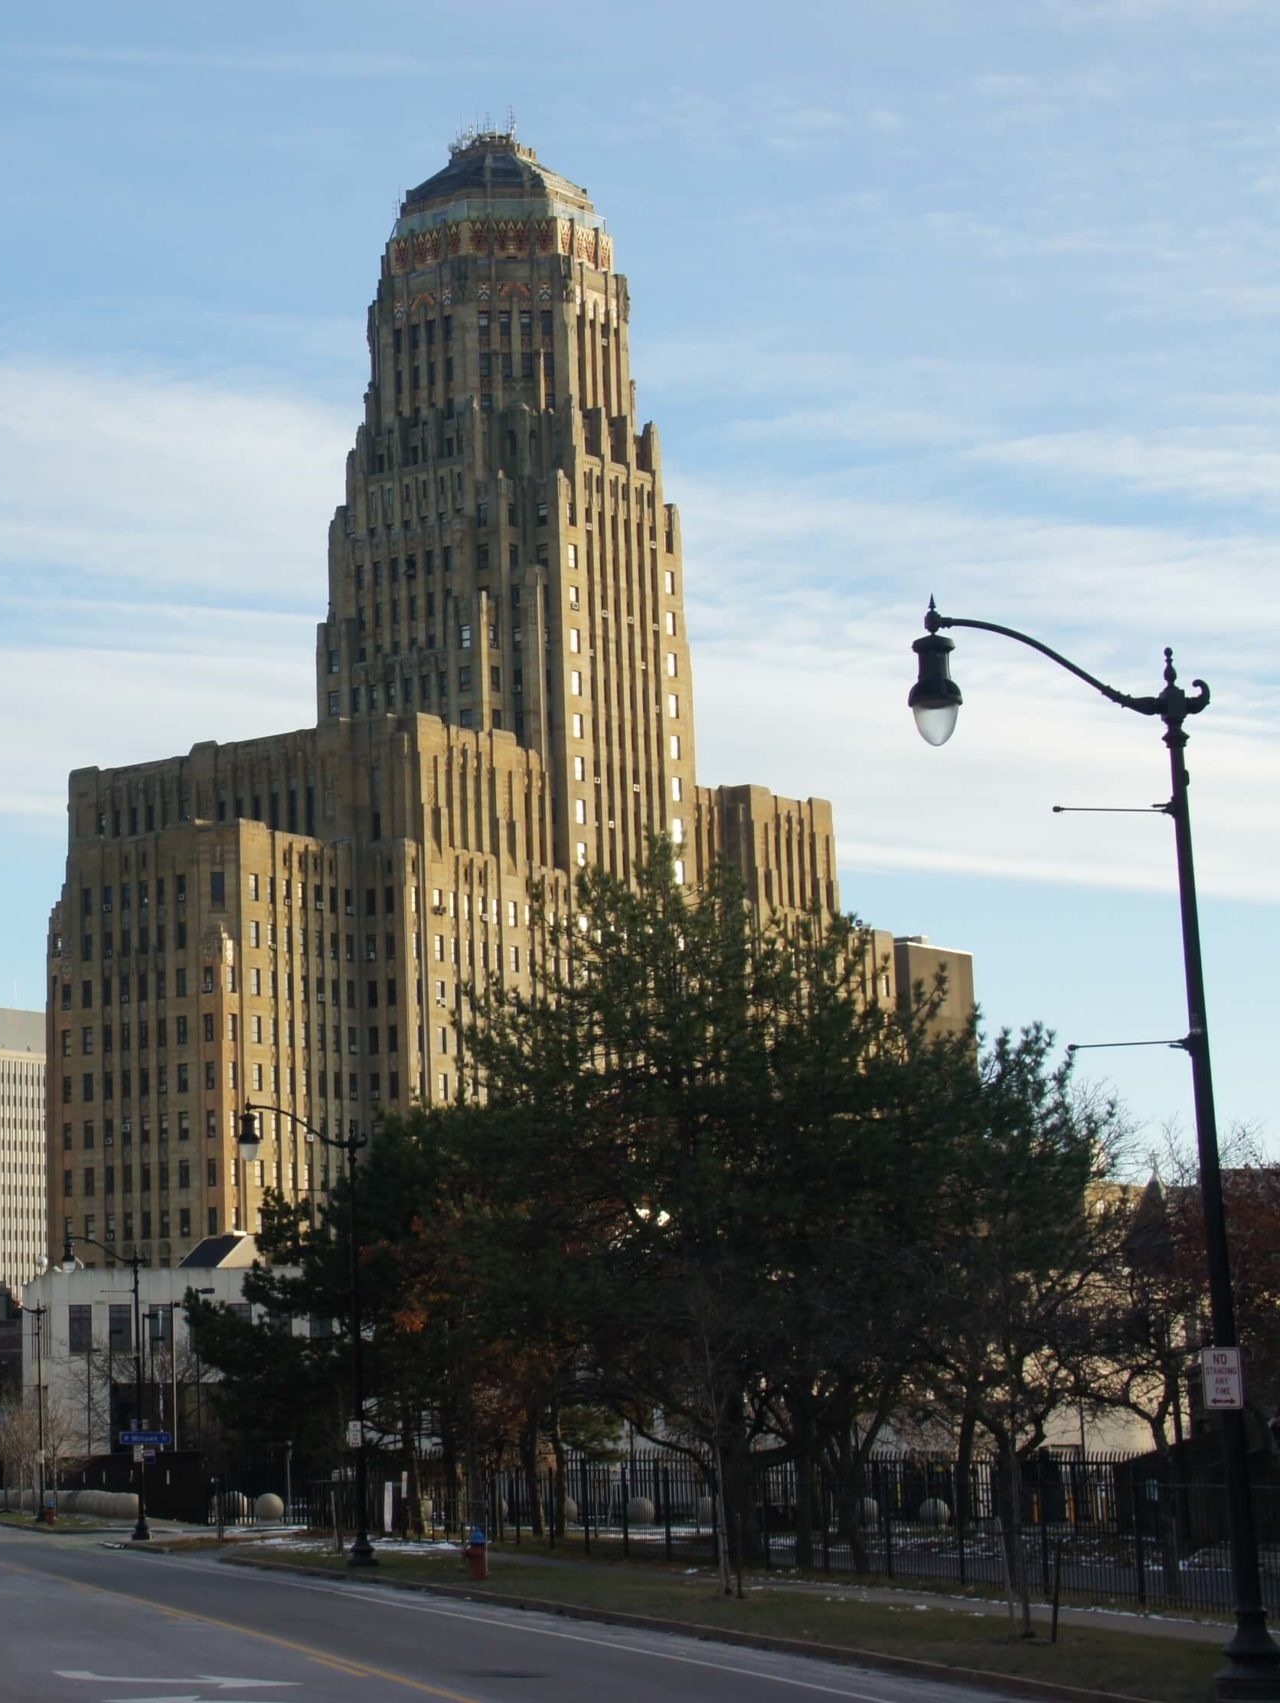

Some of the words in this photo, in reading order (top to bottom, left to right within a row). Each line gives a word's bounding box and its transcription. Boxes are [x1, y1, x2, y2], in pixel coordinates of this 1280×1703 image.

[1213, 1353, 1227, 1365] NO
[1205, 1366, 1238, 1376] STANDING
[1215, 1377, 1228, 1385] ANY
[1215, 1387, 1231, 1396] TIME
